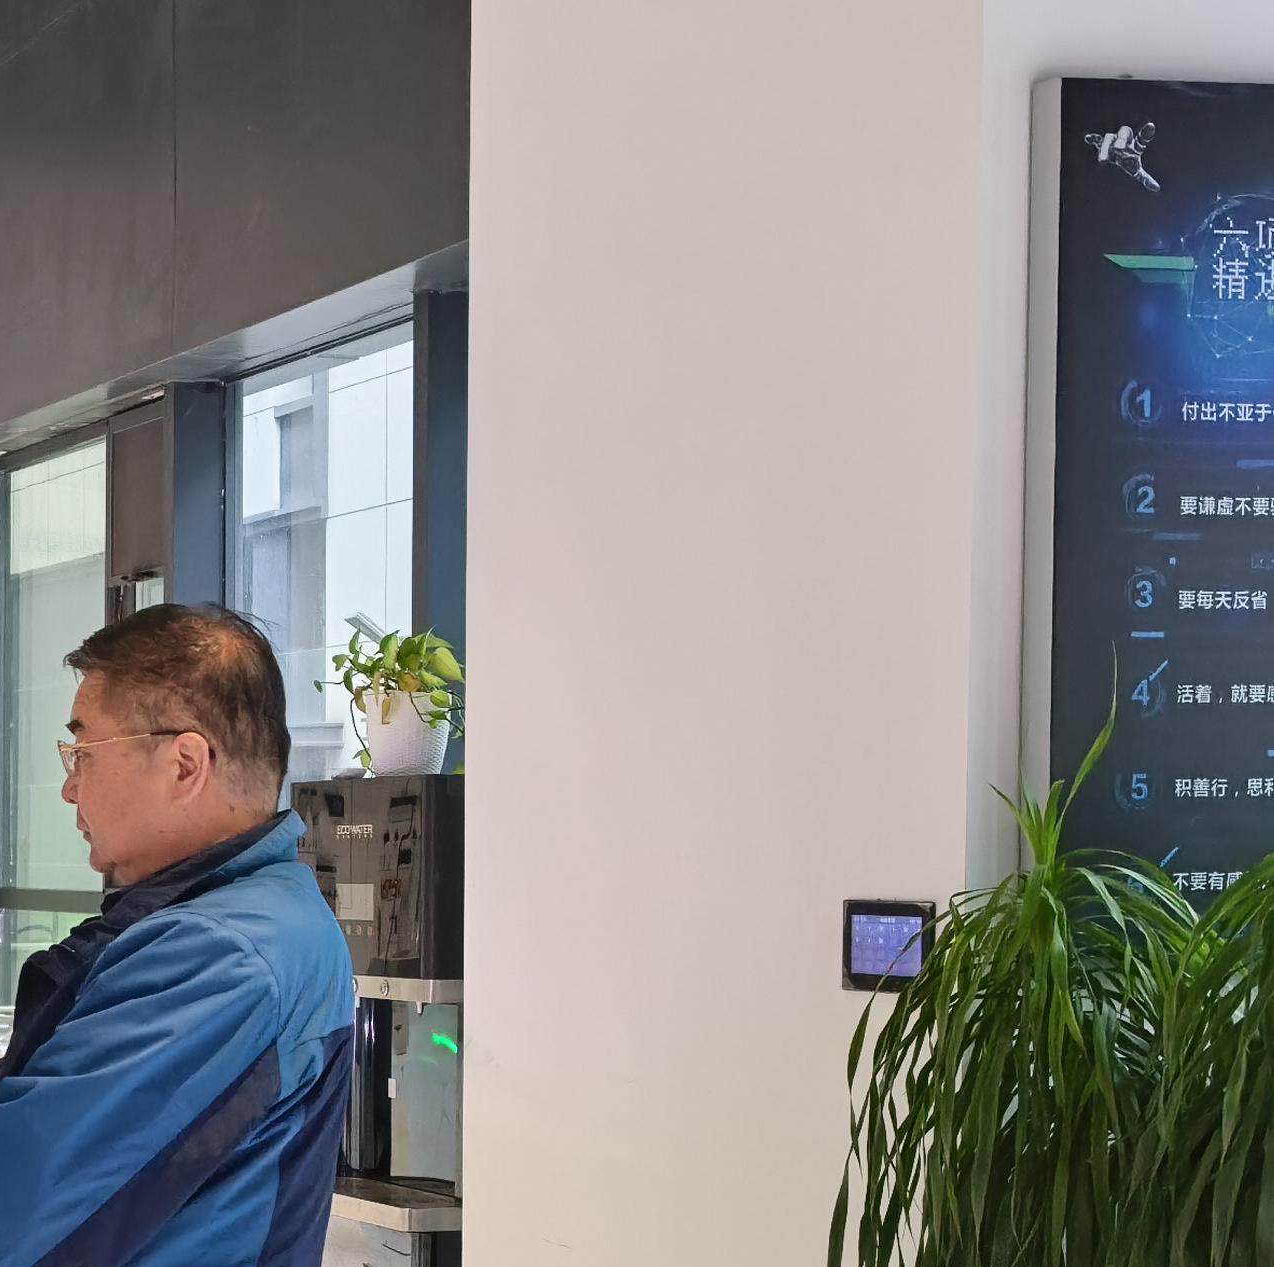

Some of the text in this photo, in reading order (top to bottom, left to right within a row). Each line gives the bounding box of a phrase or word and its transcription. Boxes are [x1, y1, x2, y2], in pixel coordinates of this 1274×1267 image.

[1181, 401, 1274, 423] 付出不亚于
[1179, 495, 1274, 516] 要谦虚不要
[1178, 589, 1269, 611] 要每天反省
